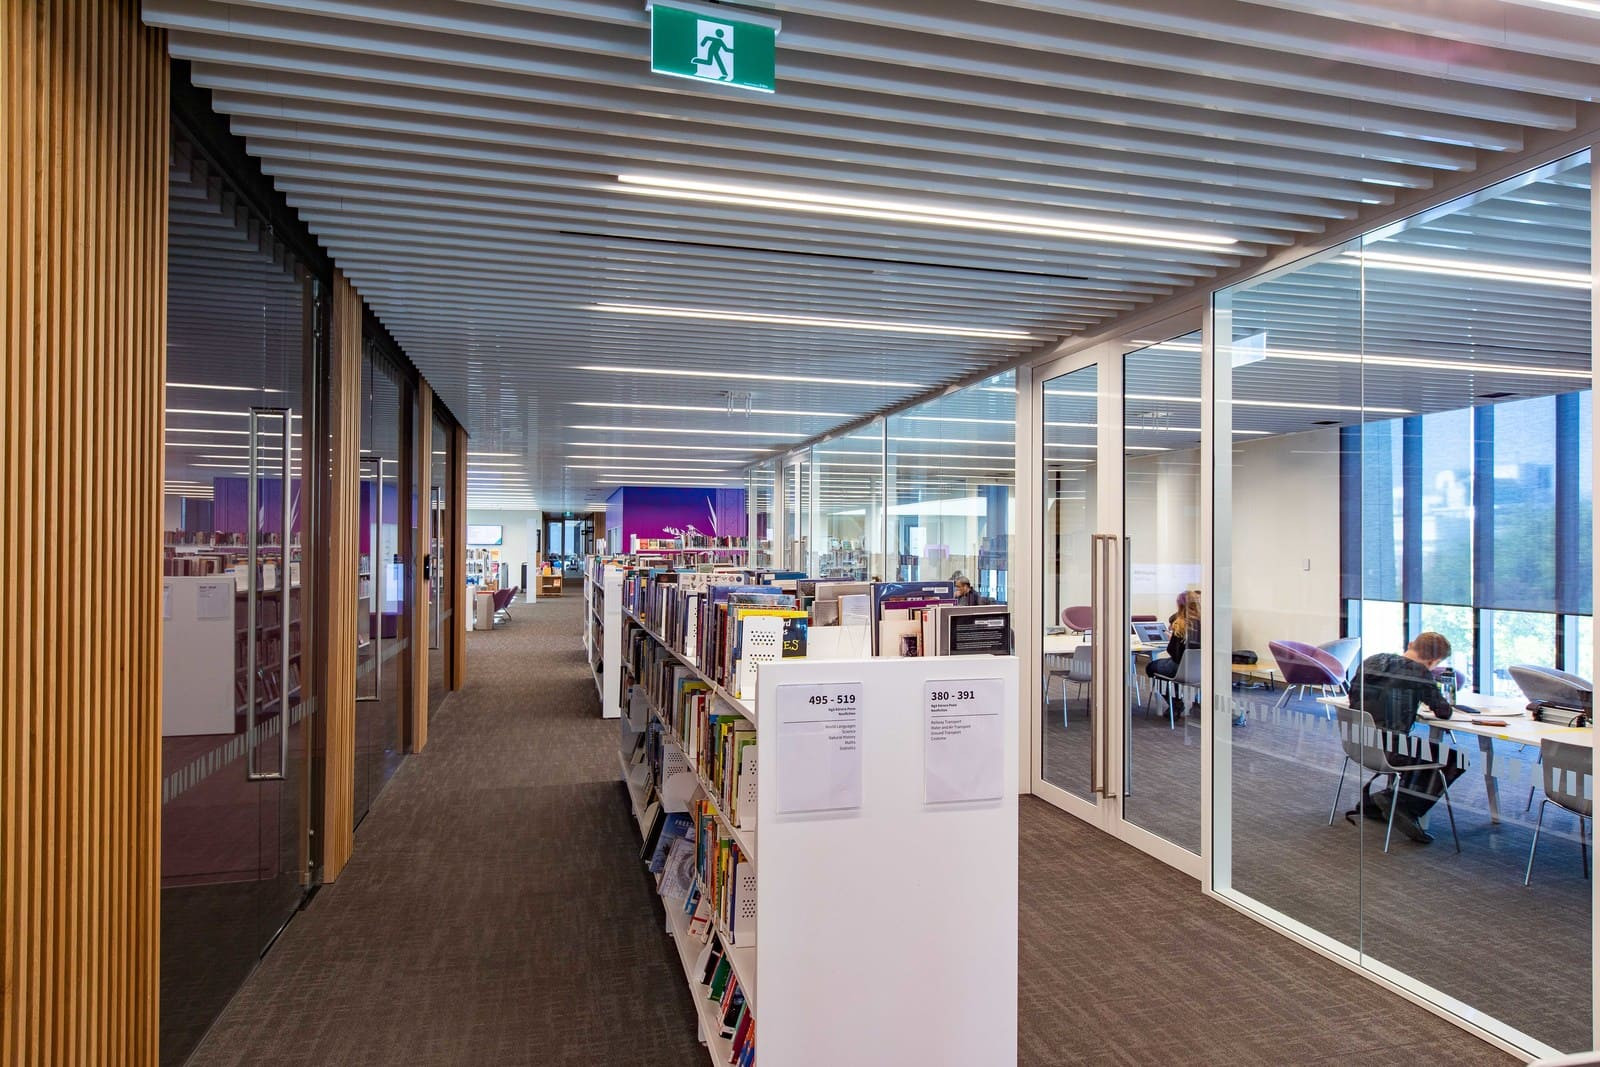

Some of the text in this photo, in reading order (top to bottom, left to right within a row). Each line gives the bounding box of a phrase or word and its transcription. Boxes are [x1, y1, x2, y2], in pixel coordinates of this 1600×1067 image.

[784, 640, 799, 650] ES
[808, 695, 828, 705] 495
[837, 694, 856, 704] 519
[931, 691, 949, 701] 380
[957, 690, 975, 700] 391
